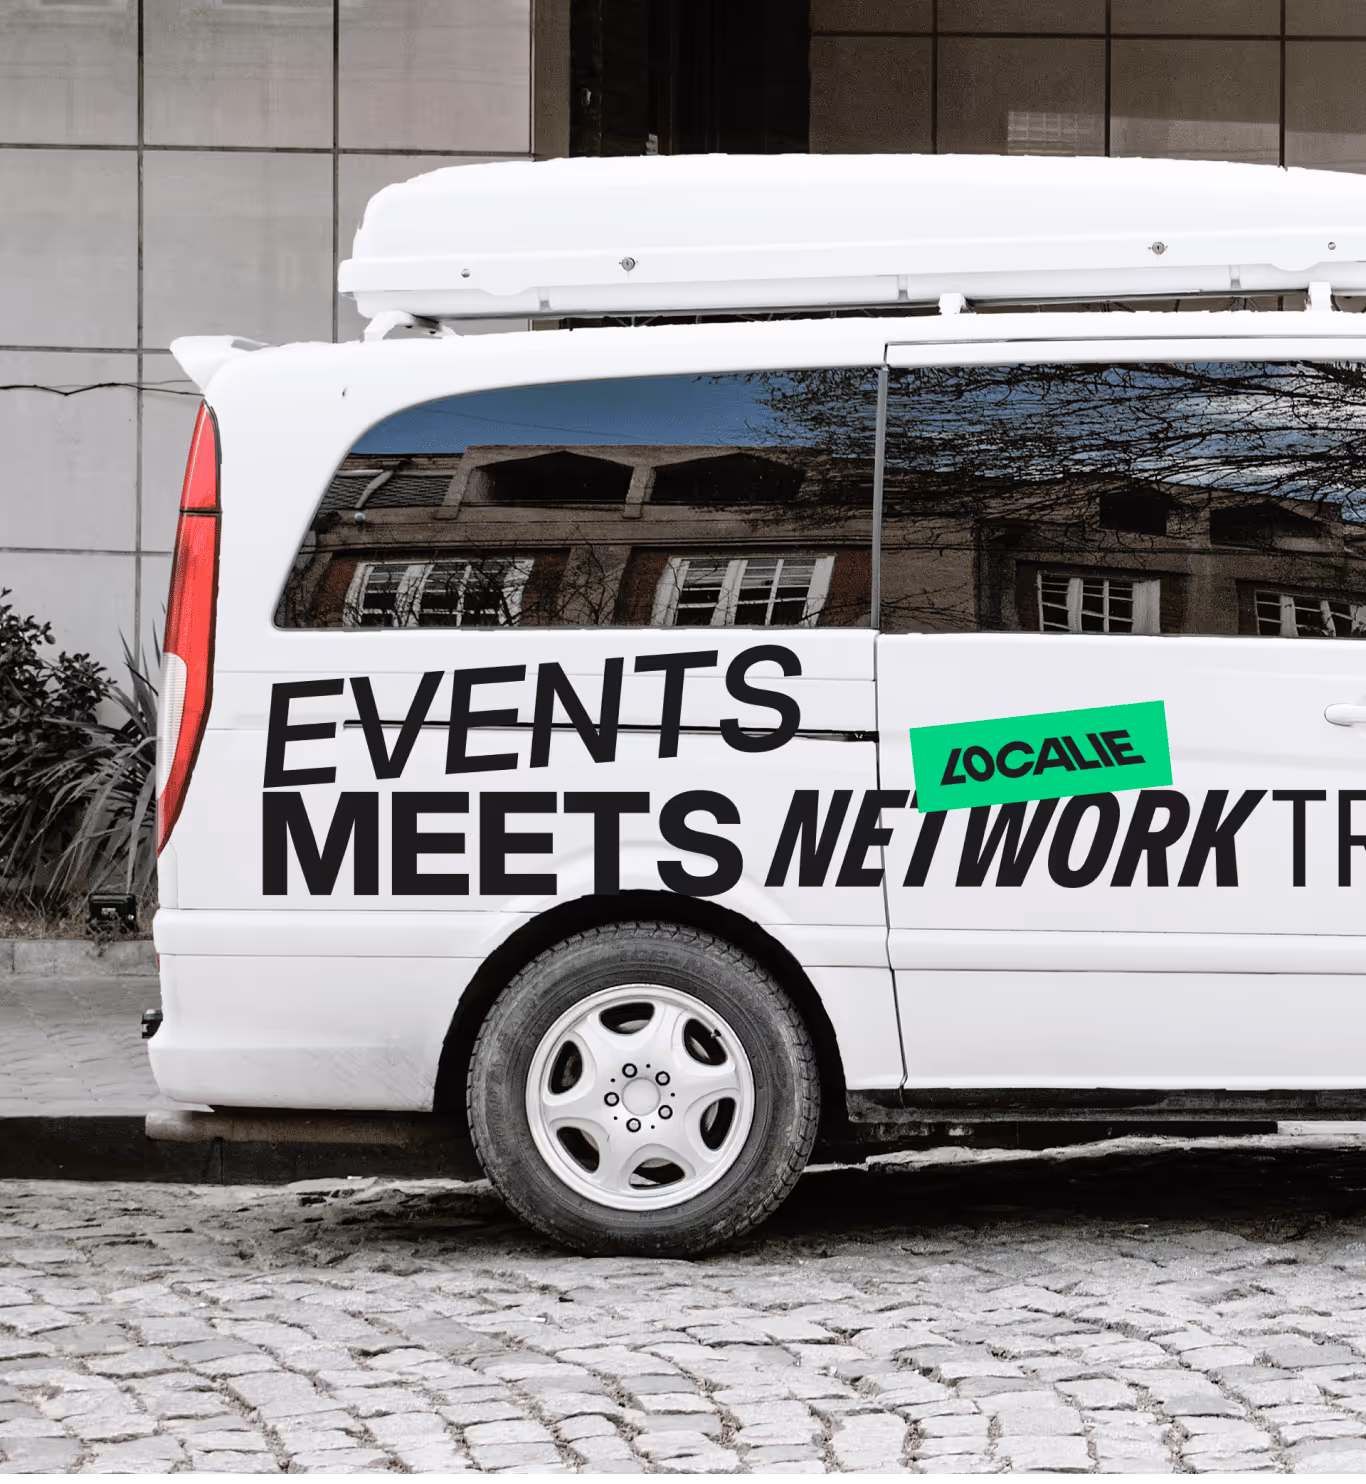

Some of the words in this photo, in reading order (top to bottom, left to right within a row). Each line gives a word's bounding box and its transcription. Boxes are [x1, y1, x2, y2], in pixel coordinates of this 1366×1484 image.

[263, 644, 802, 788] EVENTS
[940, 729, 1146, 786] LOCALIE
[262, 789, 744, 897] MEETS
[764, 789, 1268, 888] NETWORK
